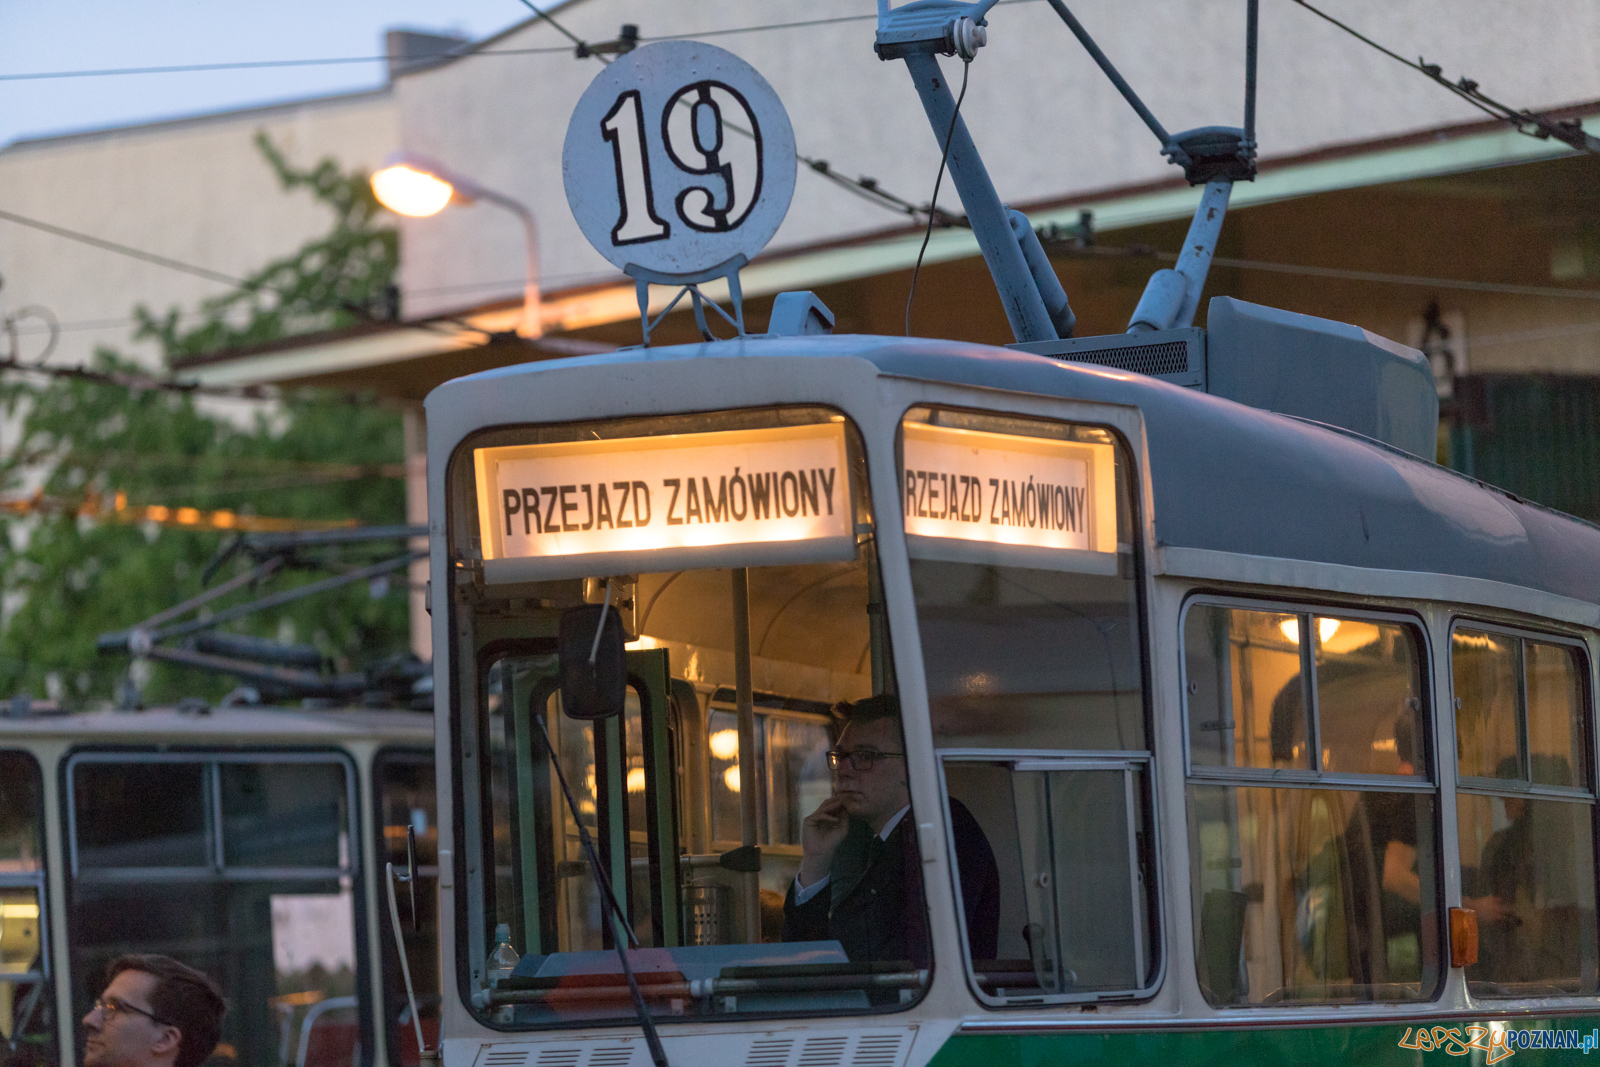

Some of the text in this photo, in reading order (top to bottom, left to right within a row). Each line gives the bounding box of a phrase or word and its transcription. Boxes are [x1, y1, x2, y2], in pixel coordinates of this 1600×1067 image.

[600, 79, 763, 246] 19
[503, 467, 836, 536] PRZEJAZD ZAMÓWIONY
[905, 469, 1085, 533] RZEJAZD ZAMÓWIONY
